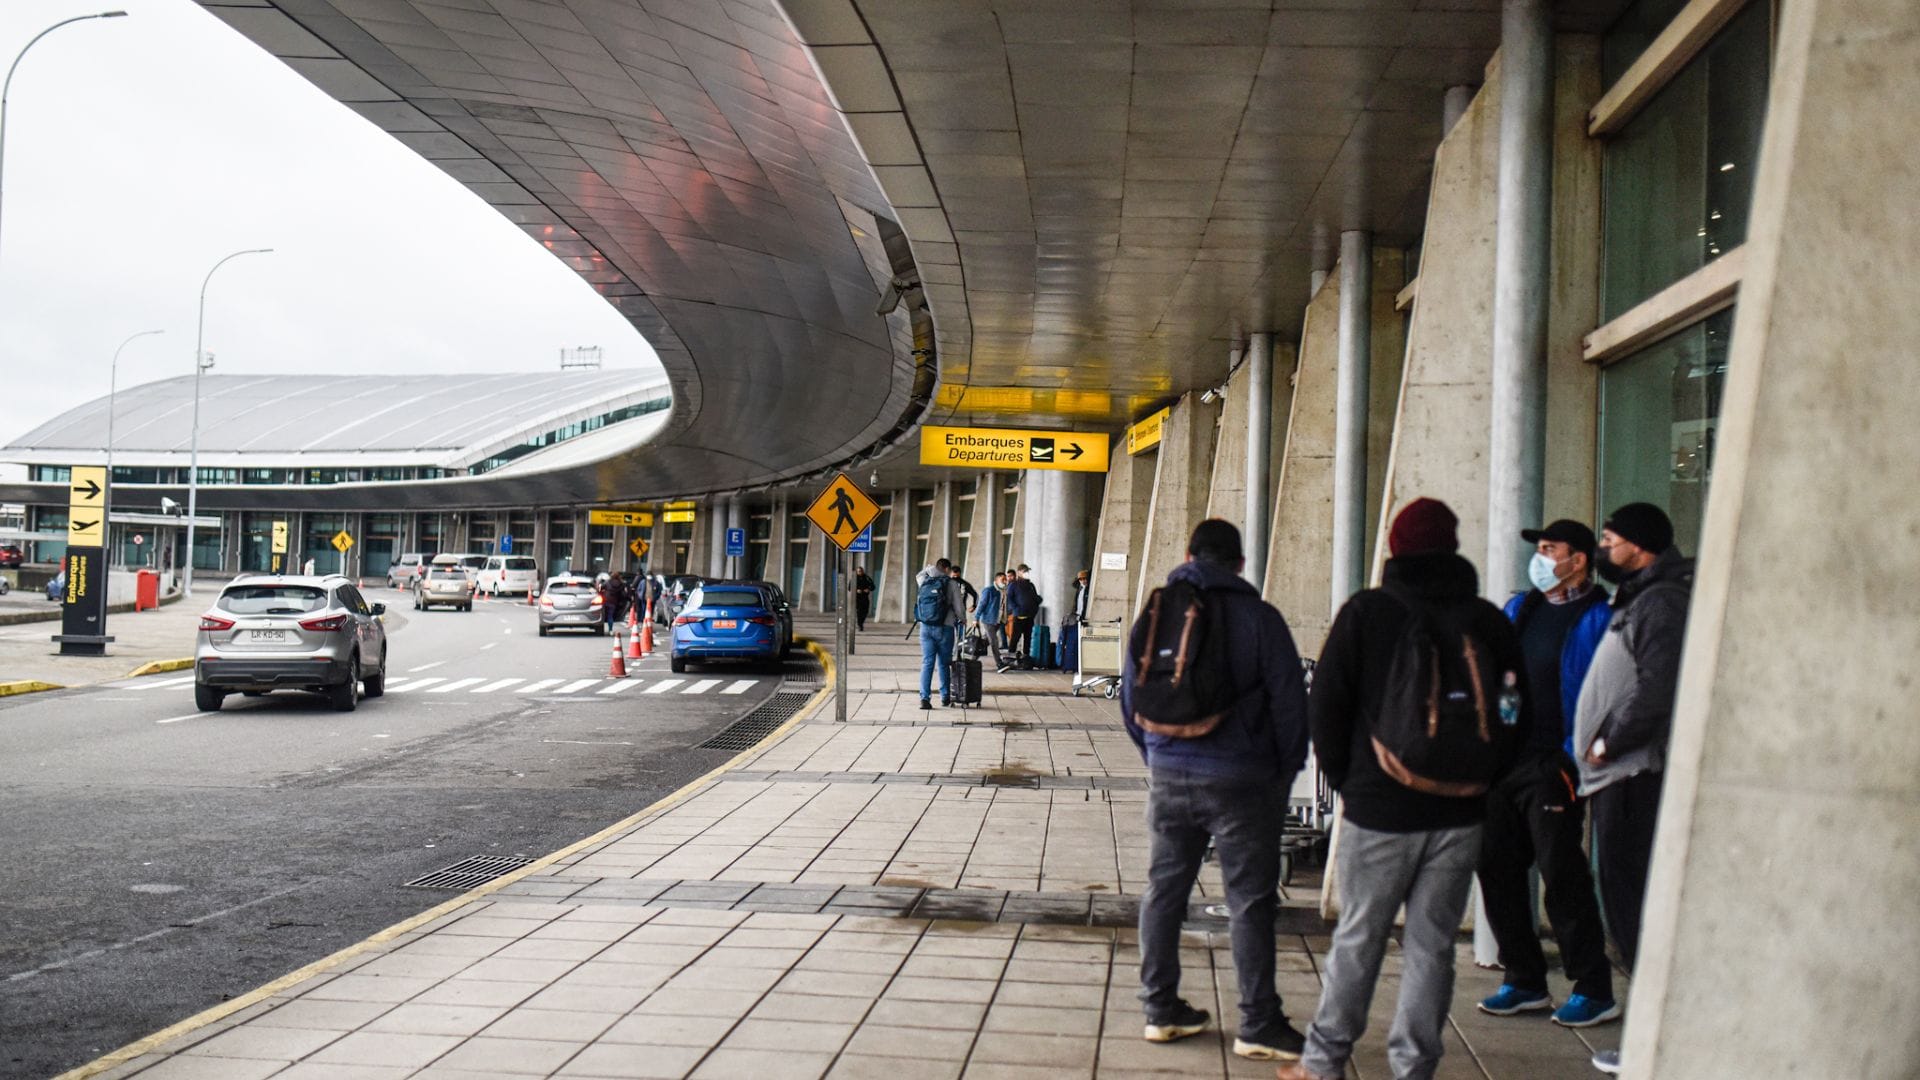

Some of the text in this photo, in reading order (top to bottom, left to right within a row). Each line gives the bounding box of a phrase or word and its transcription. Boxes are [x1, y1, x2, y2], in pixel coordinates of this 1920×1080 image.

[945, 433, 1024, 449] Embarques
[948, 447, 1023, 462] Departures
[732, 531, 740, 543] E
[66, 555, 79, 604] Embarque
